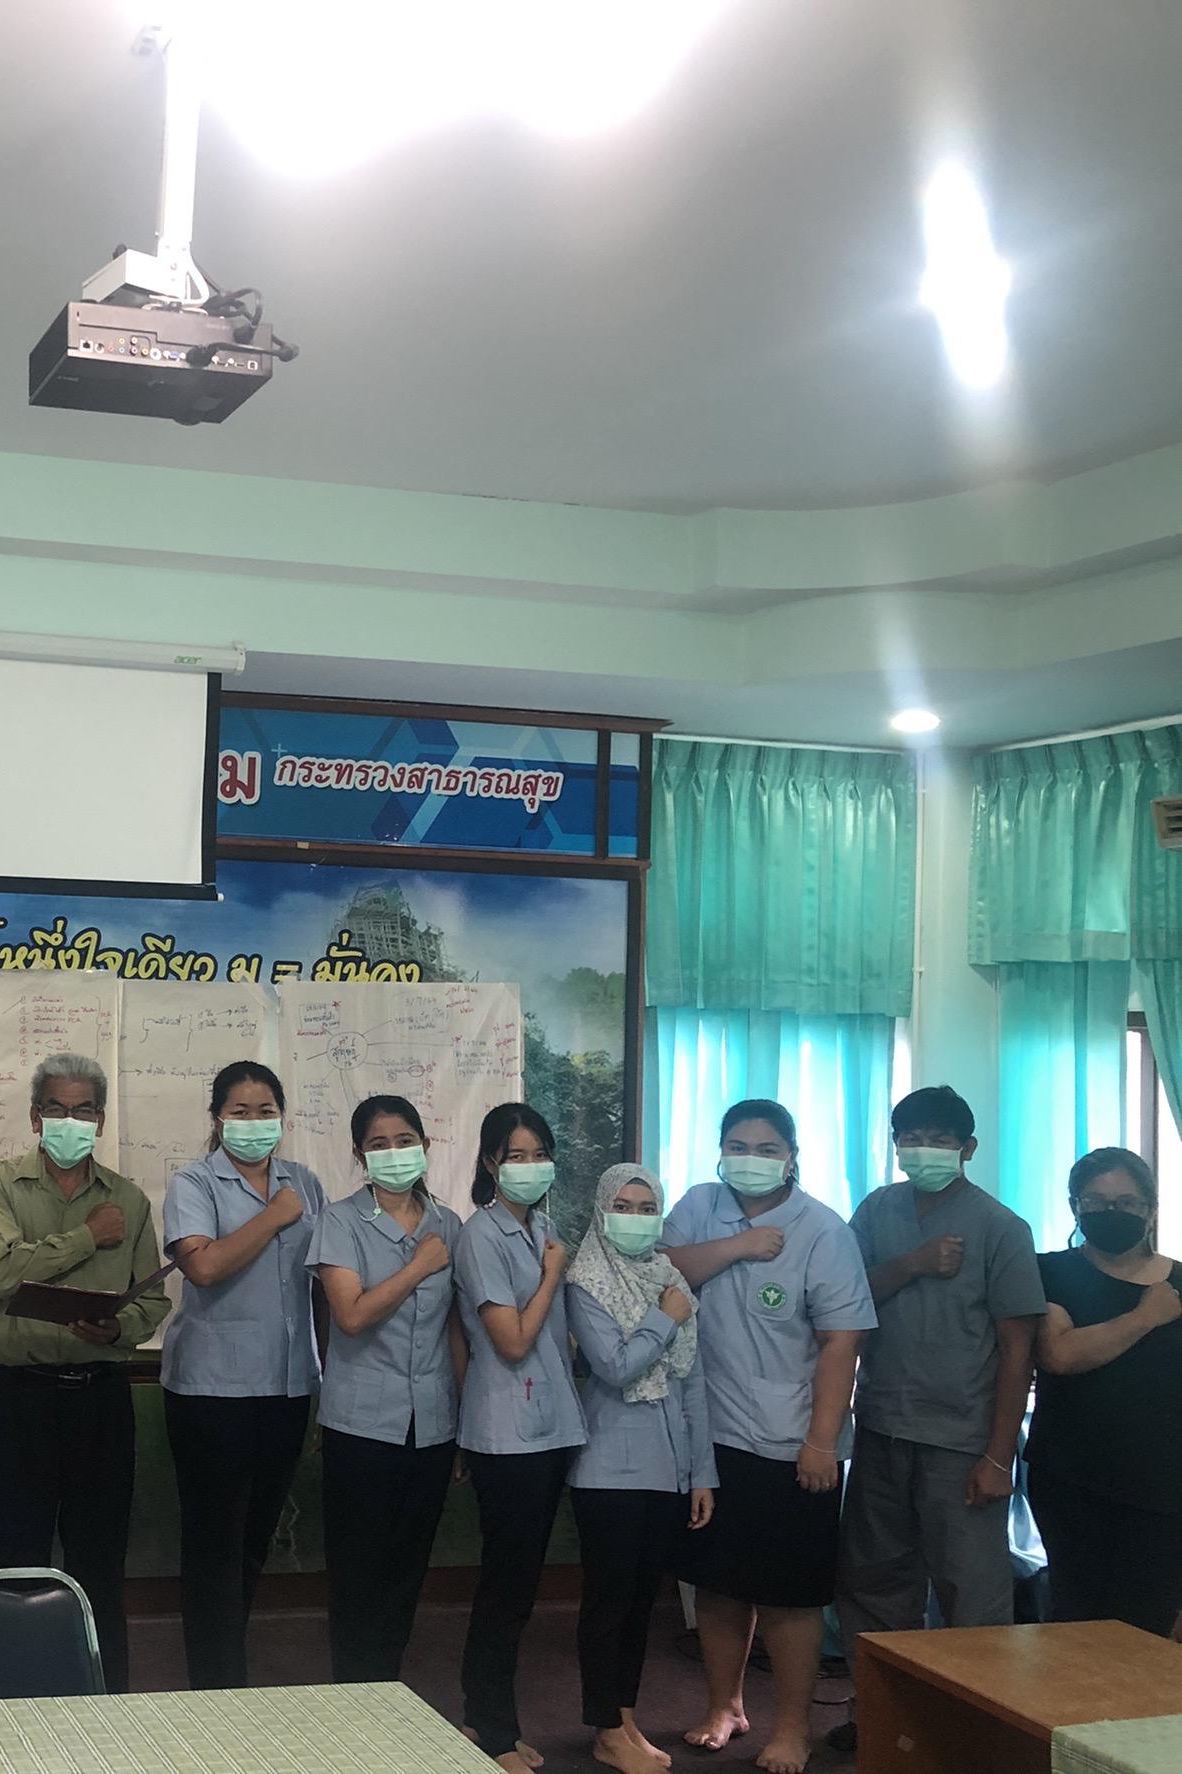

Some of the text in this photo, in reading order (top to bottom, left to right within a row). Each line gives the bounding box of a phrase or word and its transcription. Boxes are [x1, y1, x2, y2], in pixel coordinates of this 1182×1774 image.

[174, 655, 202, 664] acer
[277, 758, 561, 811] กระทรวงสาธารณสุข
